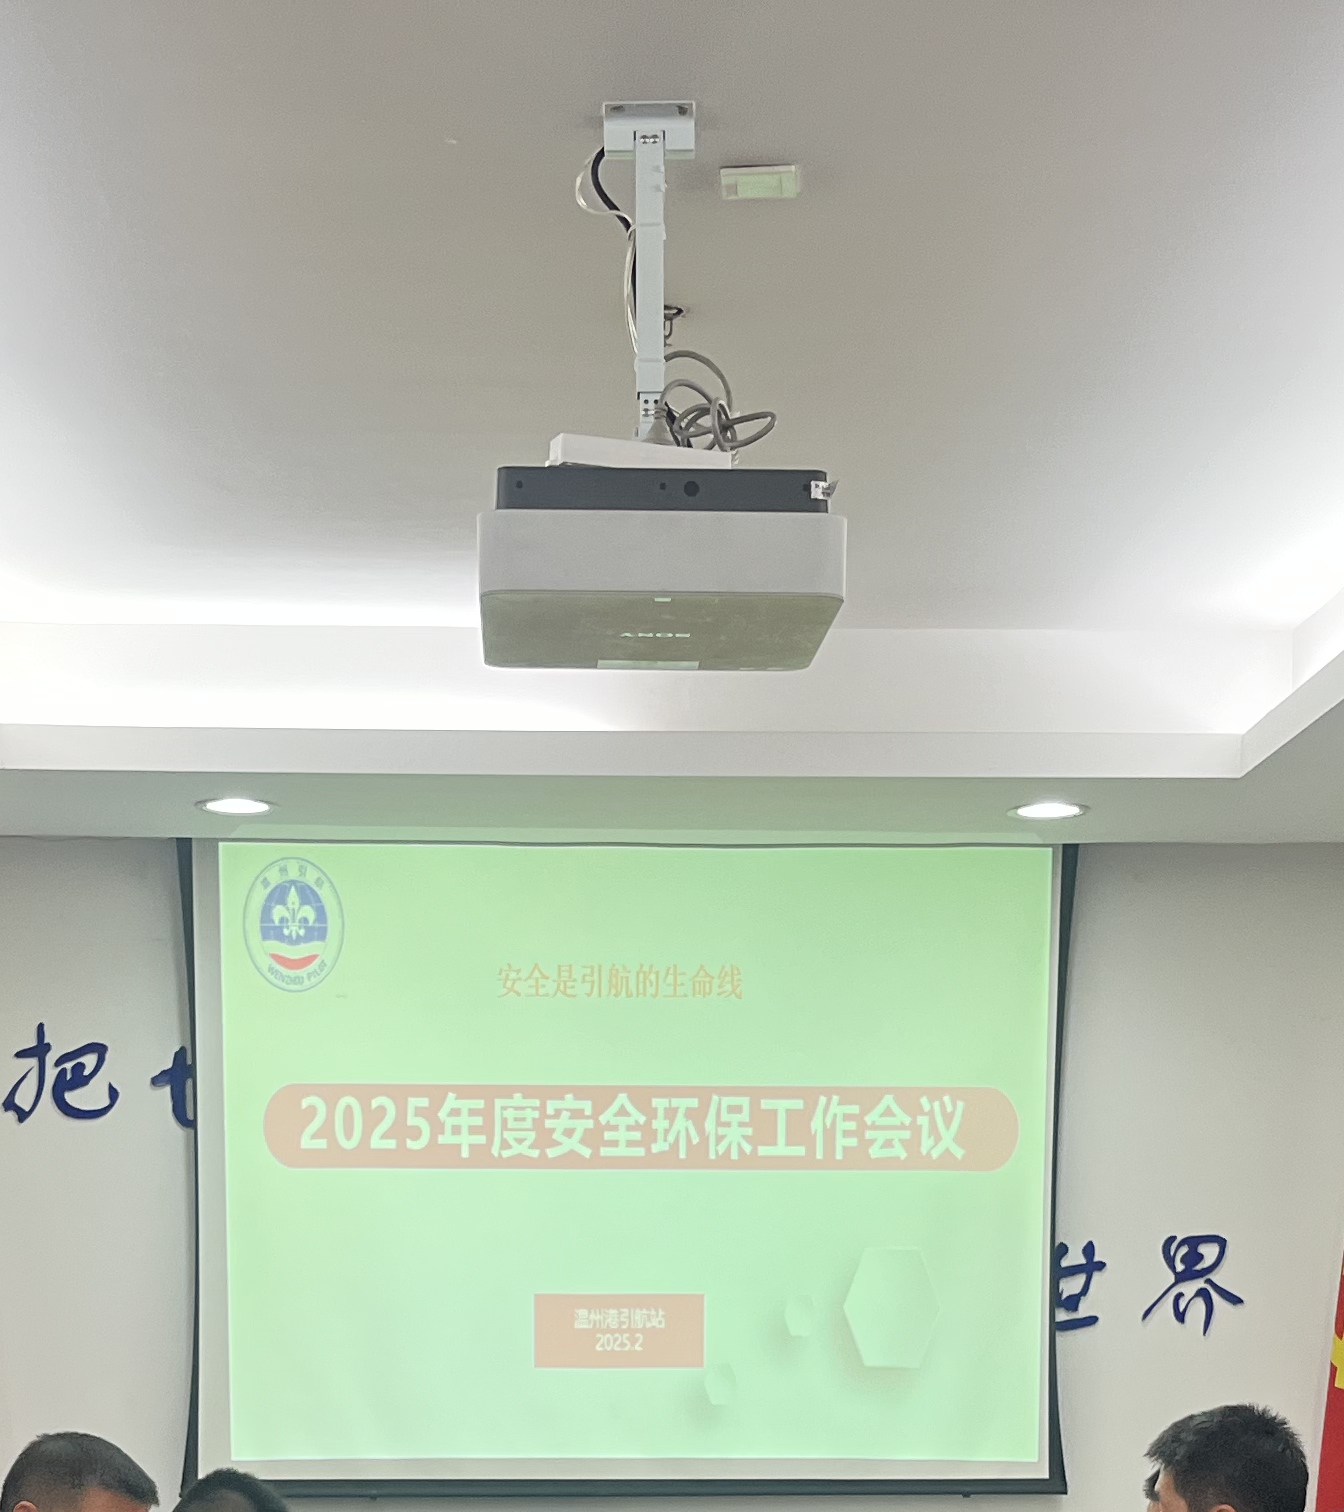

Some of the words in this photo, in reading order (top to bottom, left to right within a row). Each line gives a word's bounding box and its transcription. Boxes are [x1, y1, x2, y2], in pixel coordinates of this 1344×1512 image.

[496, 961, 744, 1002] 安全是引航的生命线
[298, 1091, 968, 1161] 2025年度安全环保工作会议
[574, 1308, 666, 1329] 温州港引航站
[595, 1333, 644, 1351] 2025.2
